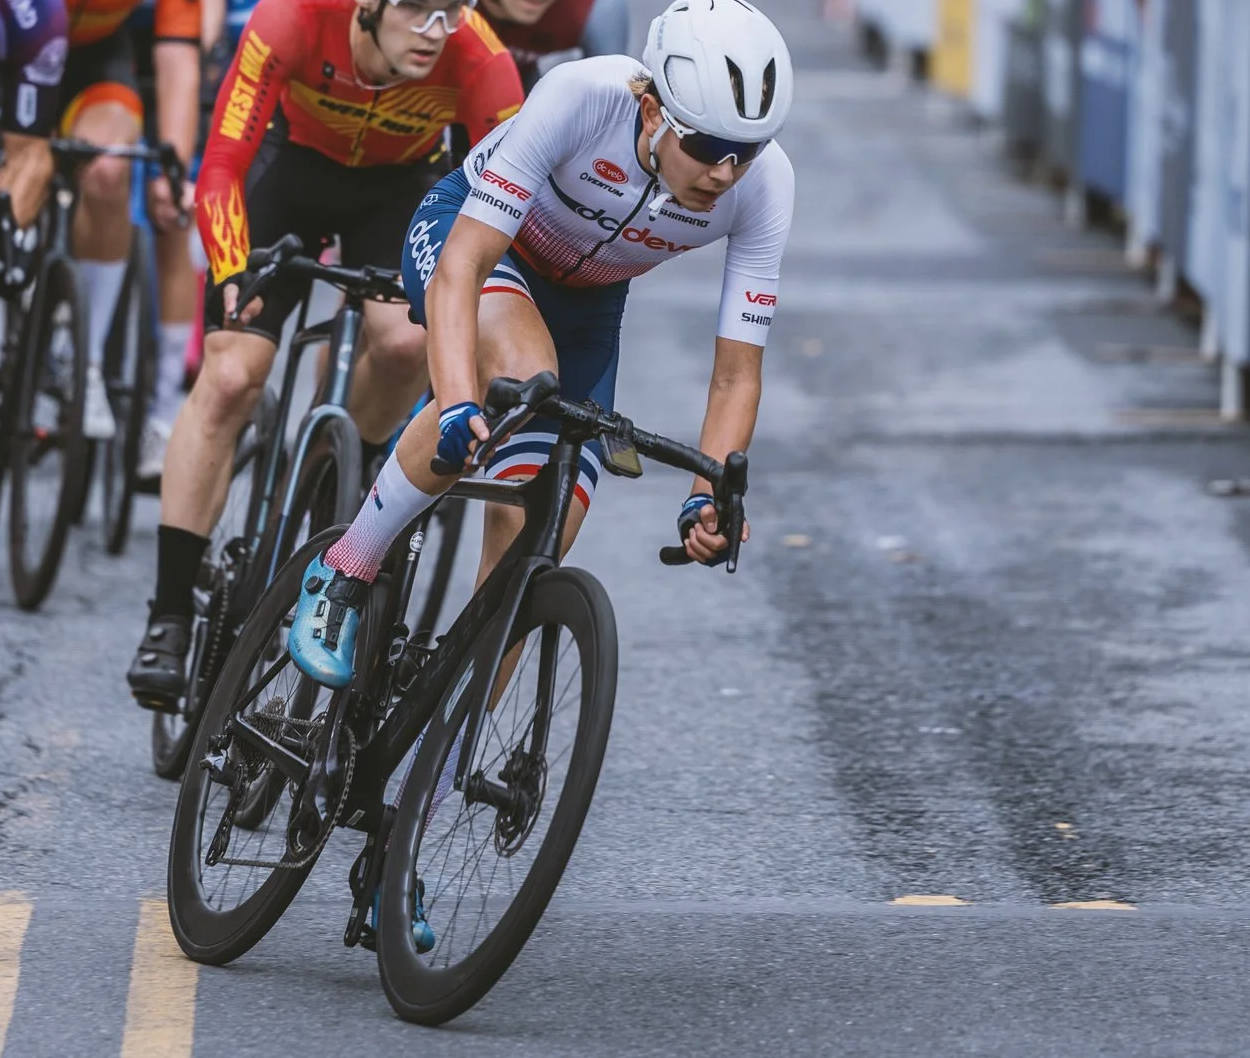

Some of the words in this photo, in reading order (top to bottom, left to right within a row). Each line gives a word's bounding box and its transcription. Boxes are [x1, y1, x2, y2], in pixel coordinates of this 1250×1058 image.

[219, 73, 257, 141] WEST
[480, 169, 532, 202] ERGE
[470, 187, 524, 220] SHIMANO
[659, 207, 711, 228] SHIMANO
